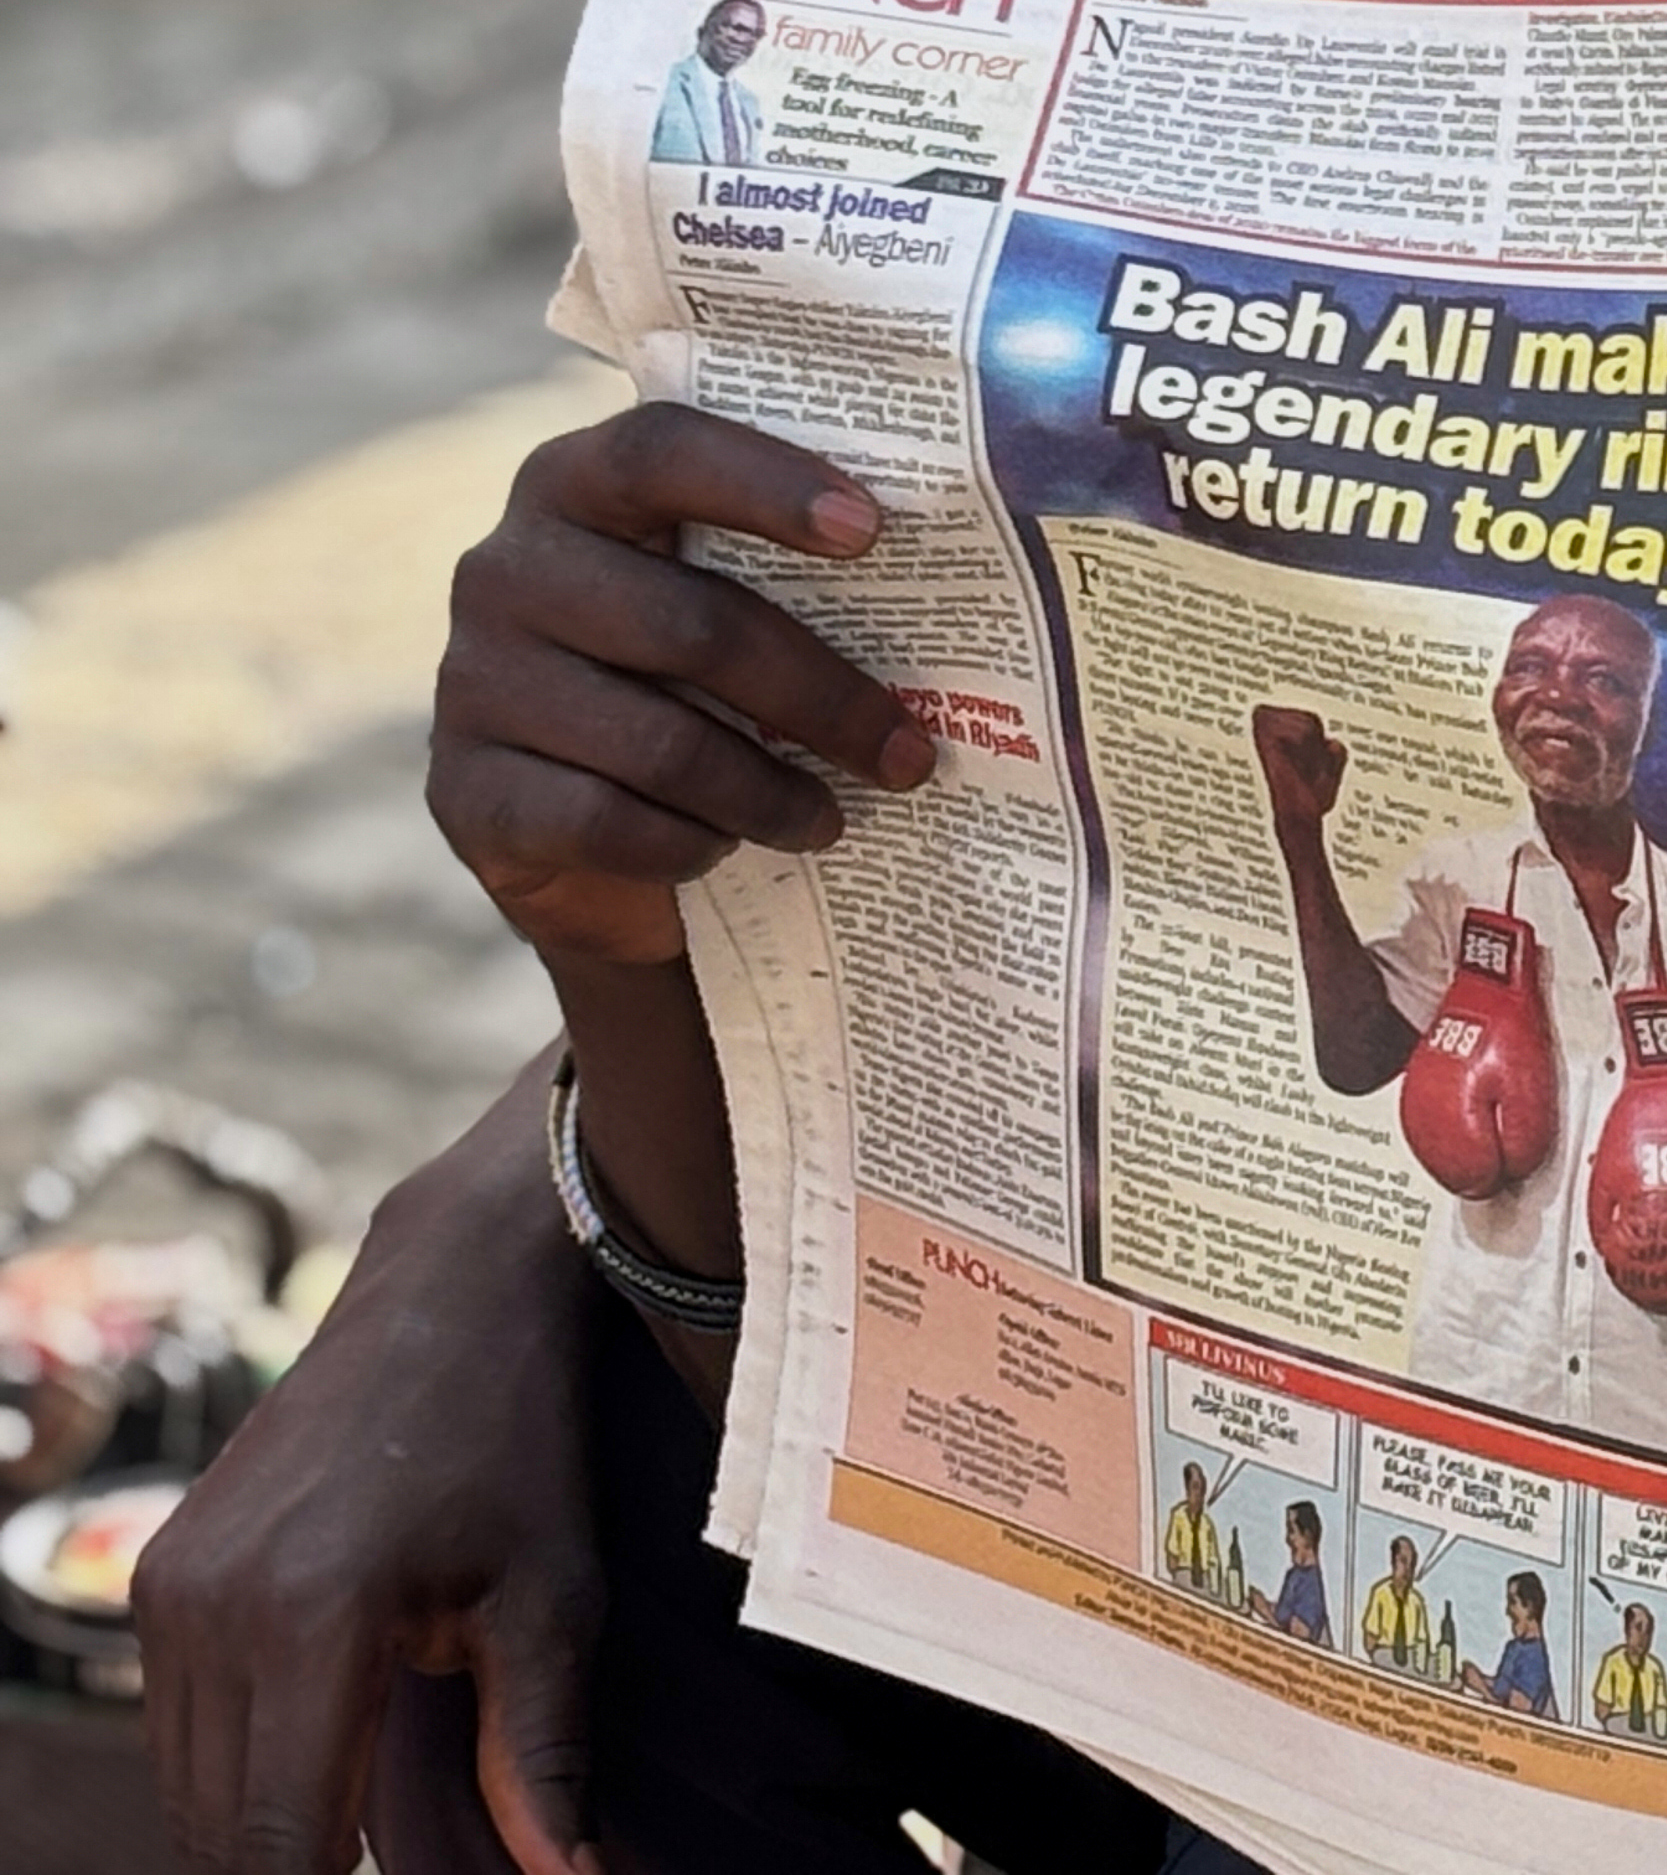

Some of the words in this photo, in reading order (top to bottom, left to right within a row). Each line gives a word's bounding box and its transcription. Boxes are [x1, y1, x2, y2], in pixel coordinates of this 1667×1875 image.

[772, 16, 888, 66] family
[893, 41, 1029, 82] corner
[673, 212, 784, 252] Chelsea
[699, 173, 708, 207] I
[715, 176, 822, 212] almost
[824, 186, 932, 225] joined
[1110, 264, 1348, 364] Bash
[1365, 304, 1493, 384] Ali
[1110, 344, 1584, 499] legendary
[1163, 449, 1428, 543] return
